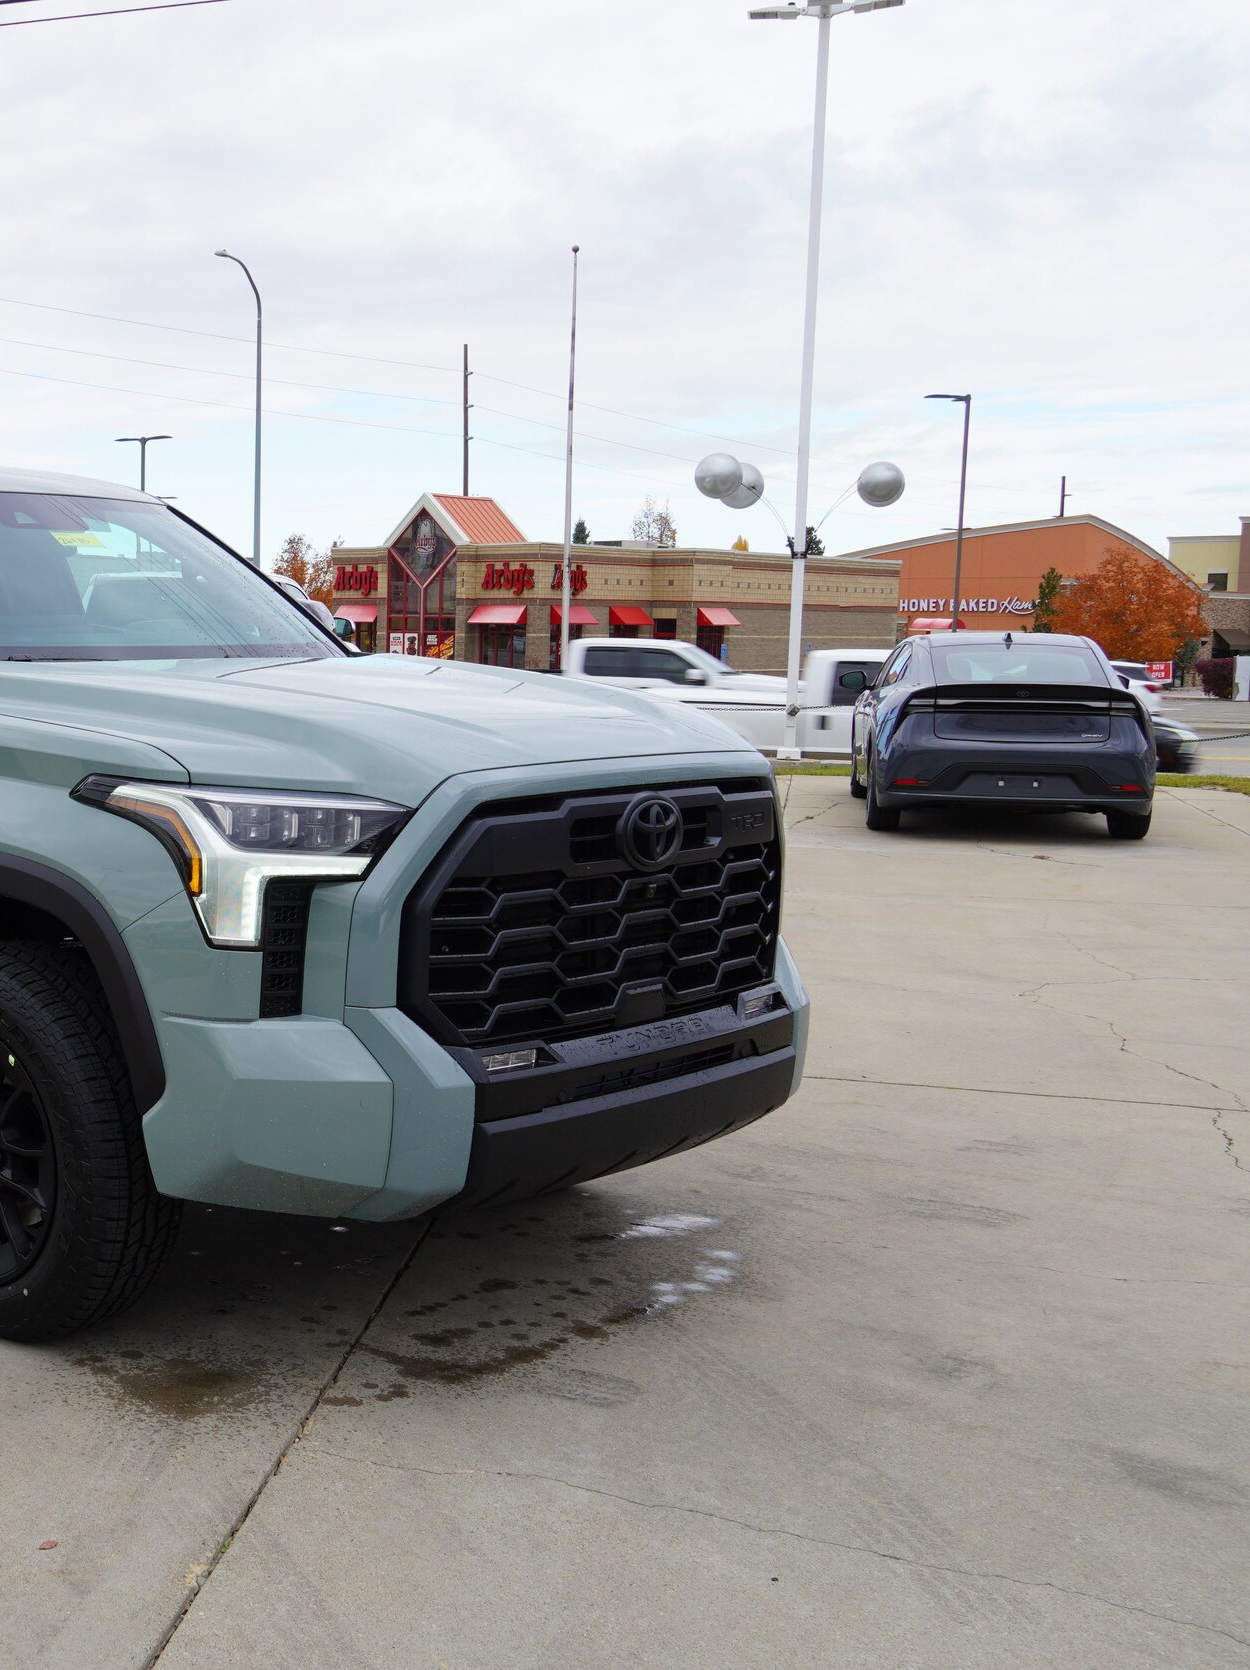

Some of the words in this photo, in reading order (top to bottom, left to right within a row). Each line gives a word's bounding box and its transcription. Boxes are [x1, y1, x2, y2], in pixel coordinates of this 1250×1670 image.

[333, 563, 378, 596] Arby's
[481, 561, 534, 595] Arby's
[899, 598, 946, 612] HONEY
[950, 598, 998, 612] AKED
[999, 596, 1035, 615] Ham
[731, 813, 764, 832] TRD
[595, 1016, 709, 1055] TUNDRA
